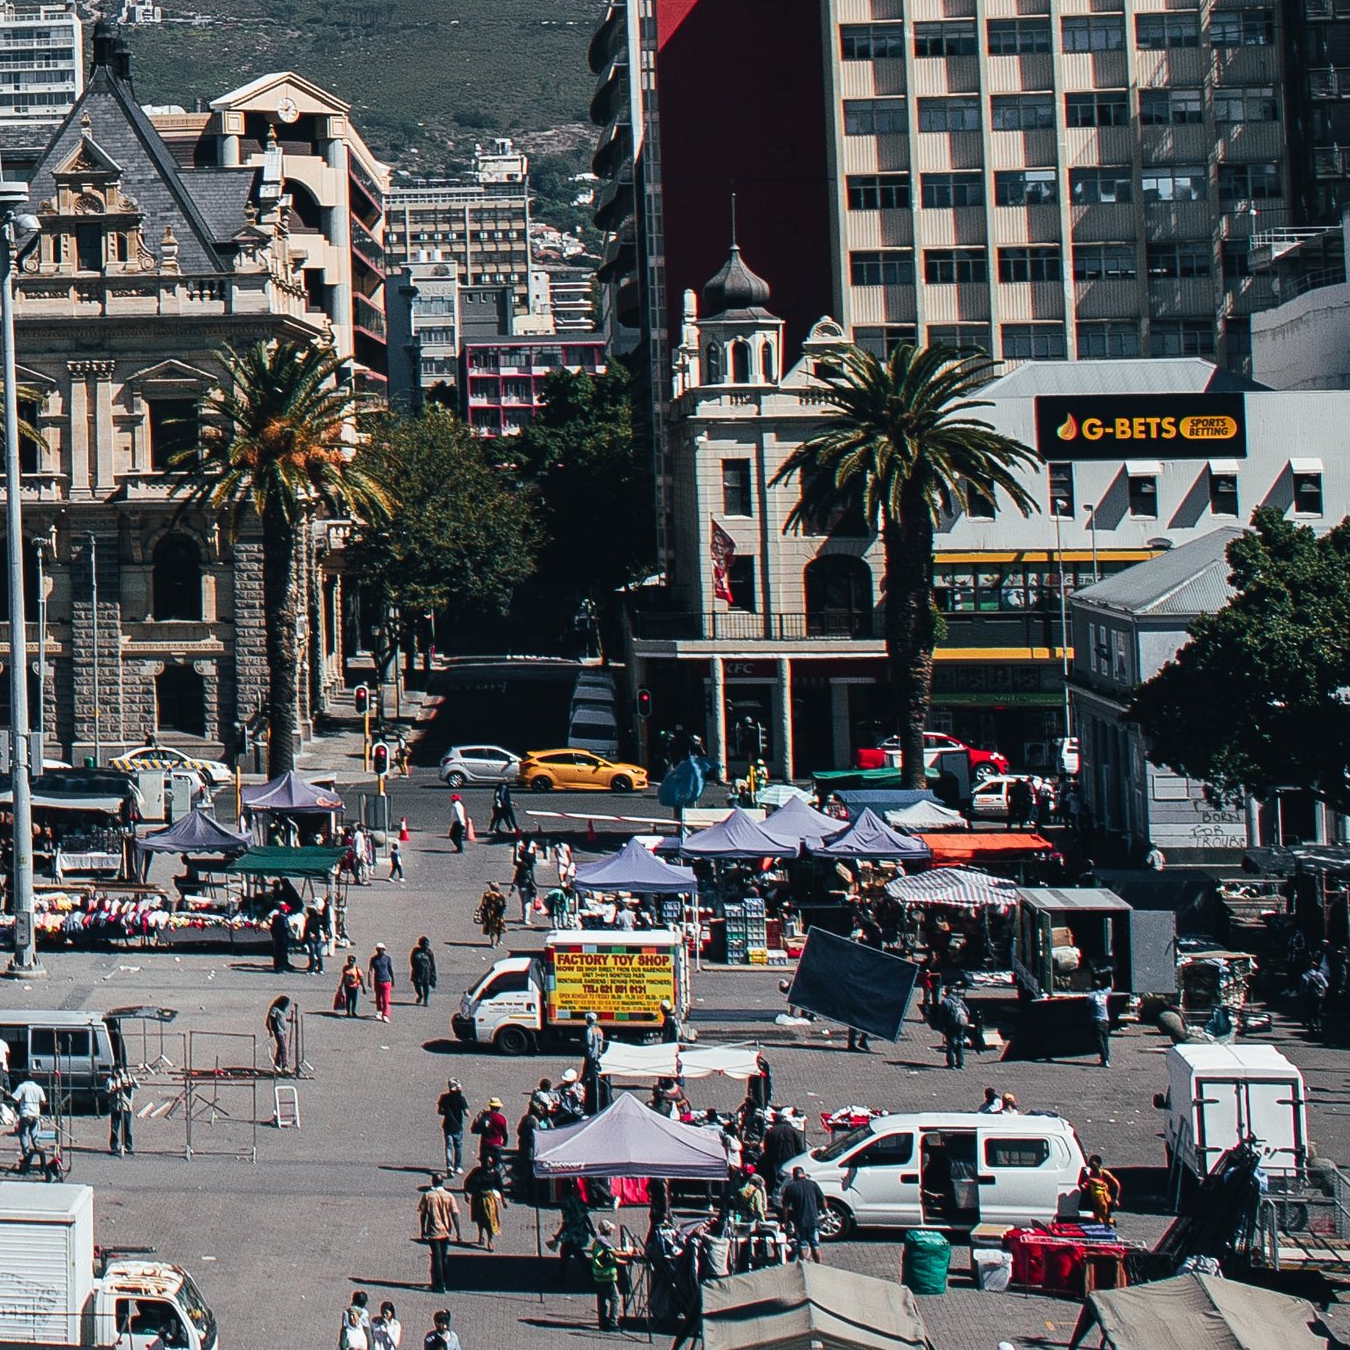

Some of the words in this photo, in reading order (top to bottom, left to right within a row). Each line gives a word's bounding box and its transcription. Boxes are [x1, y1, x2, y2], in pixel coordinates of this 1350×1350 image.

[1082, 417, 1177, 440] G-BETS
[1189, 419, 1226, 427] SPORTS
[1189, 427, 1229, 436] BETTING
[1202, 811, 1240, 823] BORN
[557, 954, 609, 965] FACTORY
[612, 955, 634, 965] TOY
[638, 956, 670, 966] SHOP
